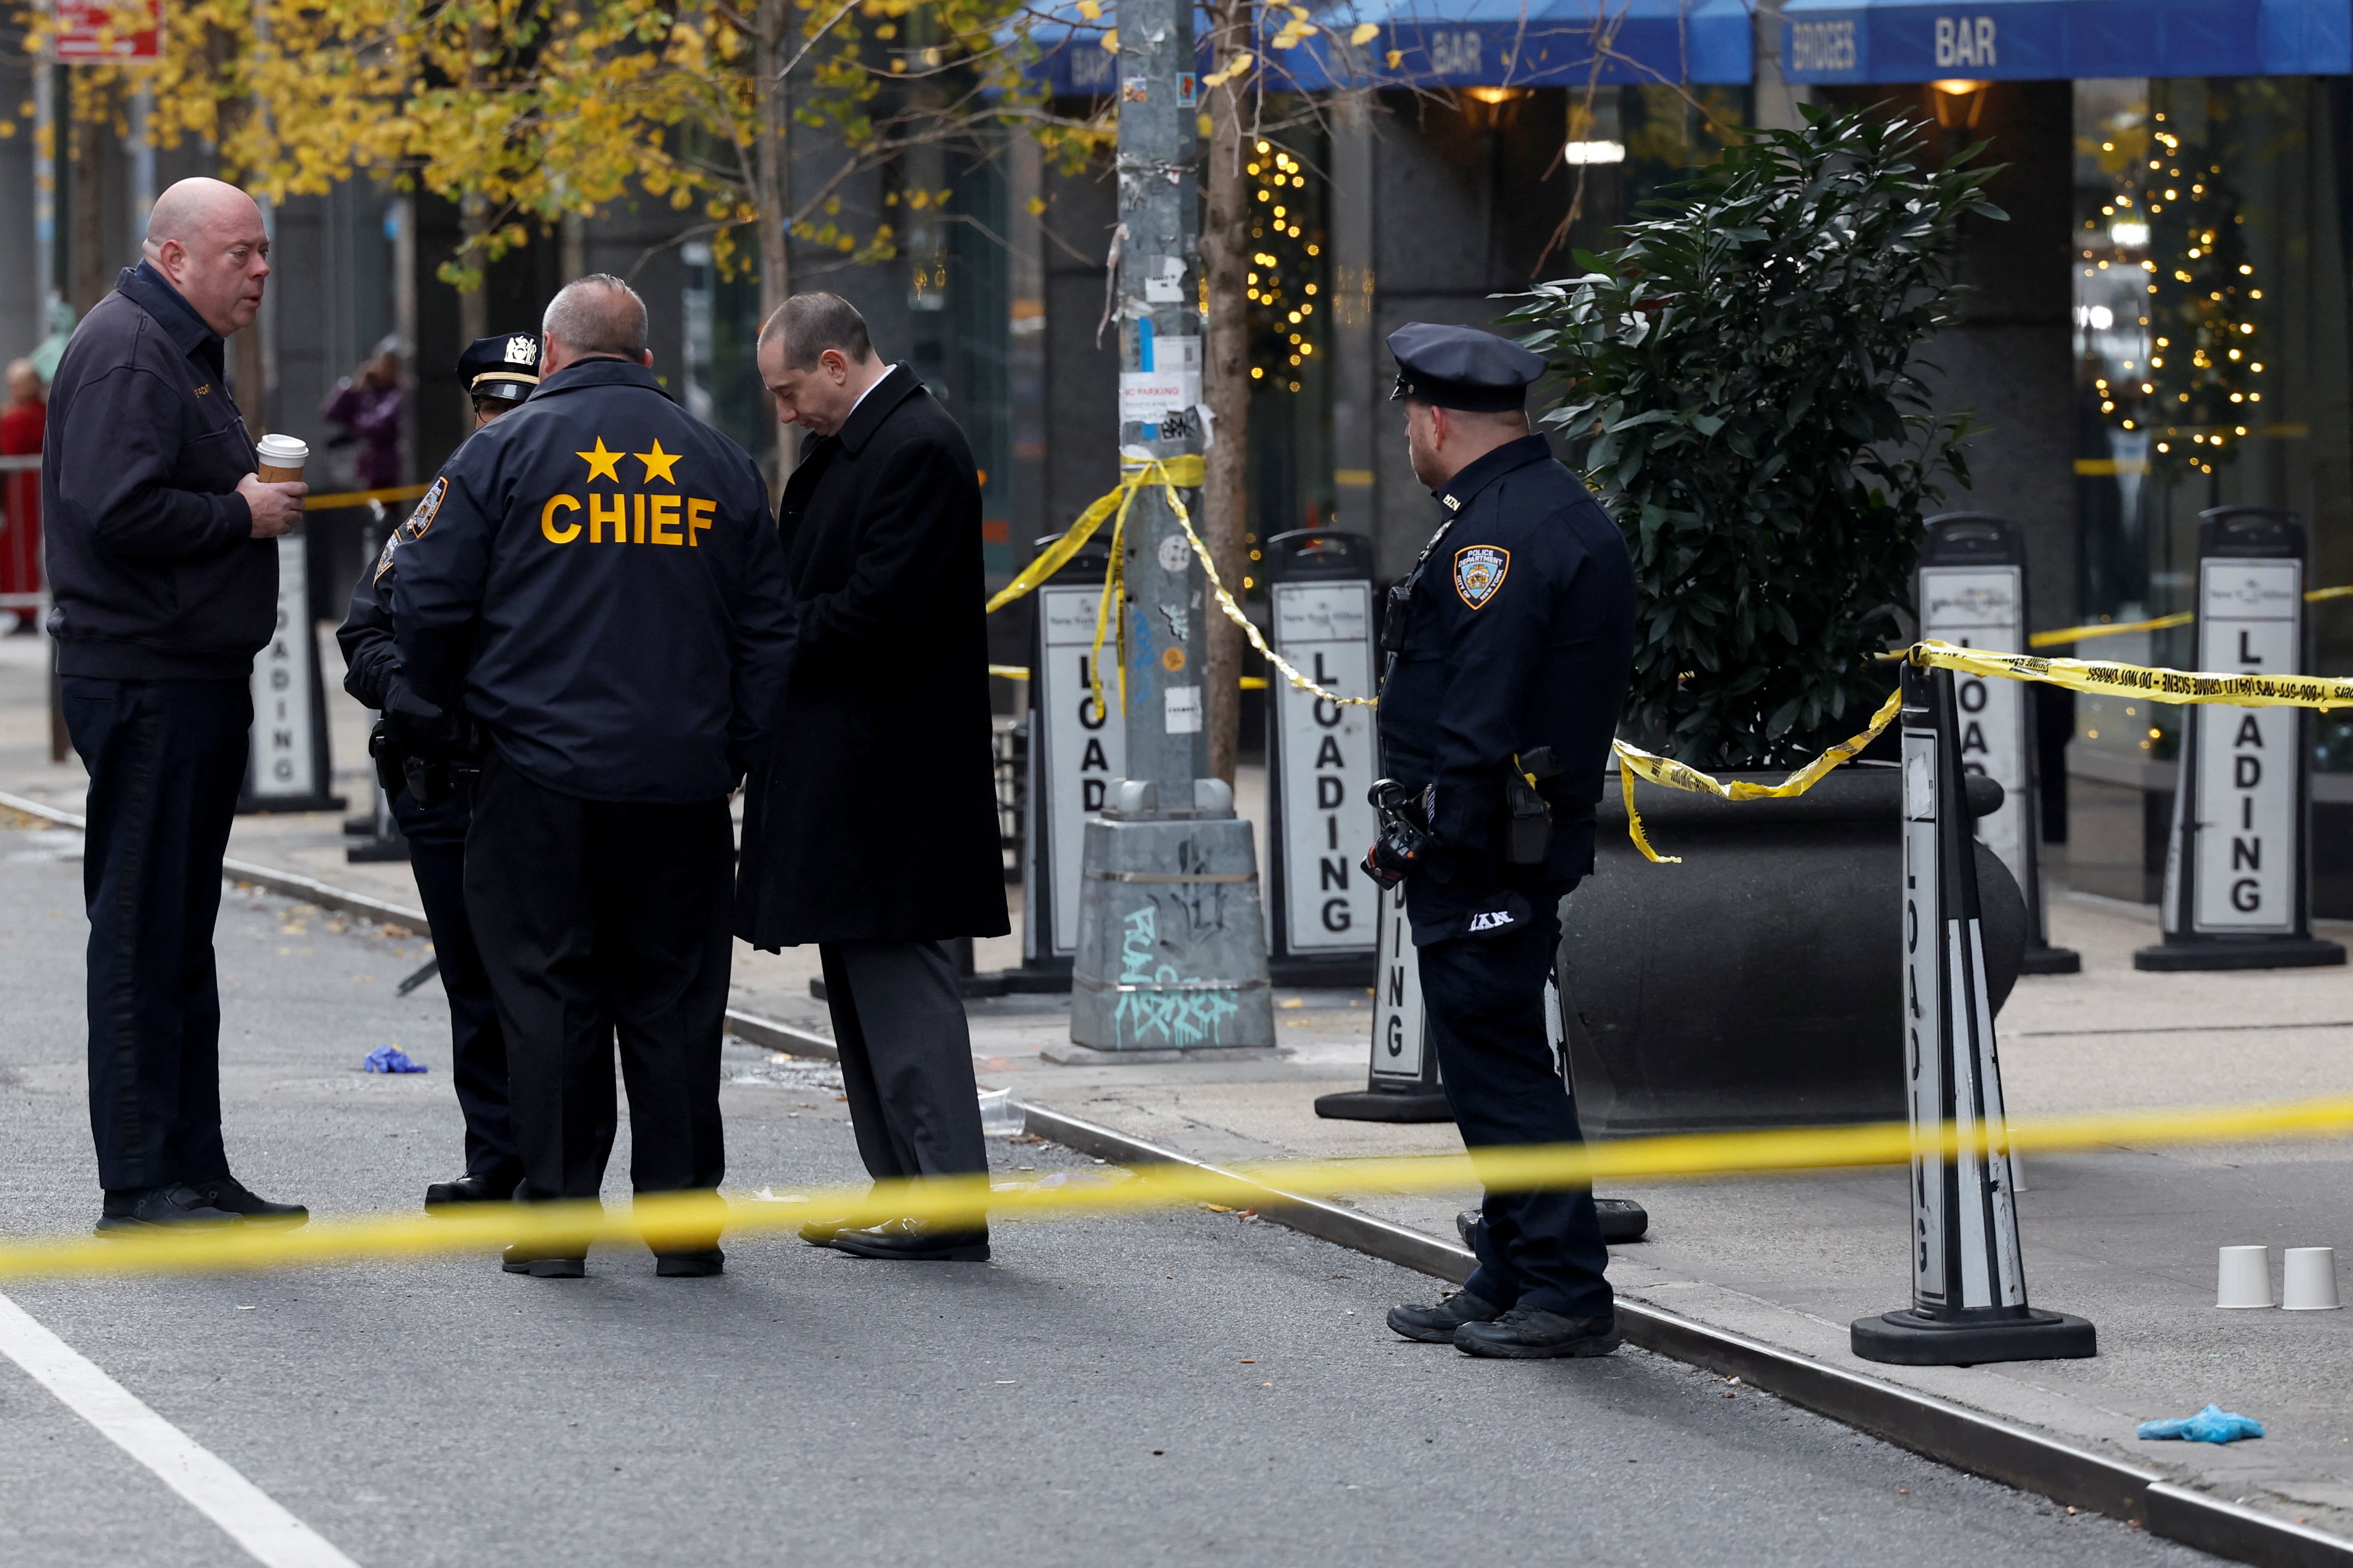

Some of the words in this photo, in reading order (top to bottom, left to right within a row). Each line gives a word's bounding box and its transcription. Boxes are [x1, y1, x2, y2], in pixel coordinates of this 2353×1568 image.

[1935, 16, 1997, 68] BAR
[428, 501, 439, 517] YORK
[541, 493, 717, 547] CHIEF
[1458, 555, 1503, 568] DEPARTMENT
[1467, 549, 1494, 558] POLICE
[1457, 575, 1465, 590] CITY
[1462, 590, 1471, 599] OF
[1479, 587, 1493, 601] NEW
[1490, 569, 1504, 587] YORK
[2086, 666, 2118, 685] CROSS
[2118, 669, 2139, 687] NOT
[2139, 671, 2153, 689] DO
[2162, 673, 2191, 695] SCENE
[2192, 677, 2223, 696] CRIME
[270, 610, 294, 782] OADING
[1079, 655, 1109, 812] LOAD
[2231, 631, 2262, 912] LADING
[1314, 653, 1351, 933] LOADING
[1387, 880, 1406, 1057] DING
